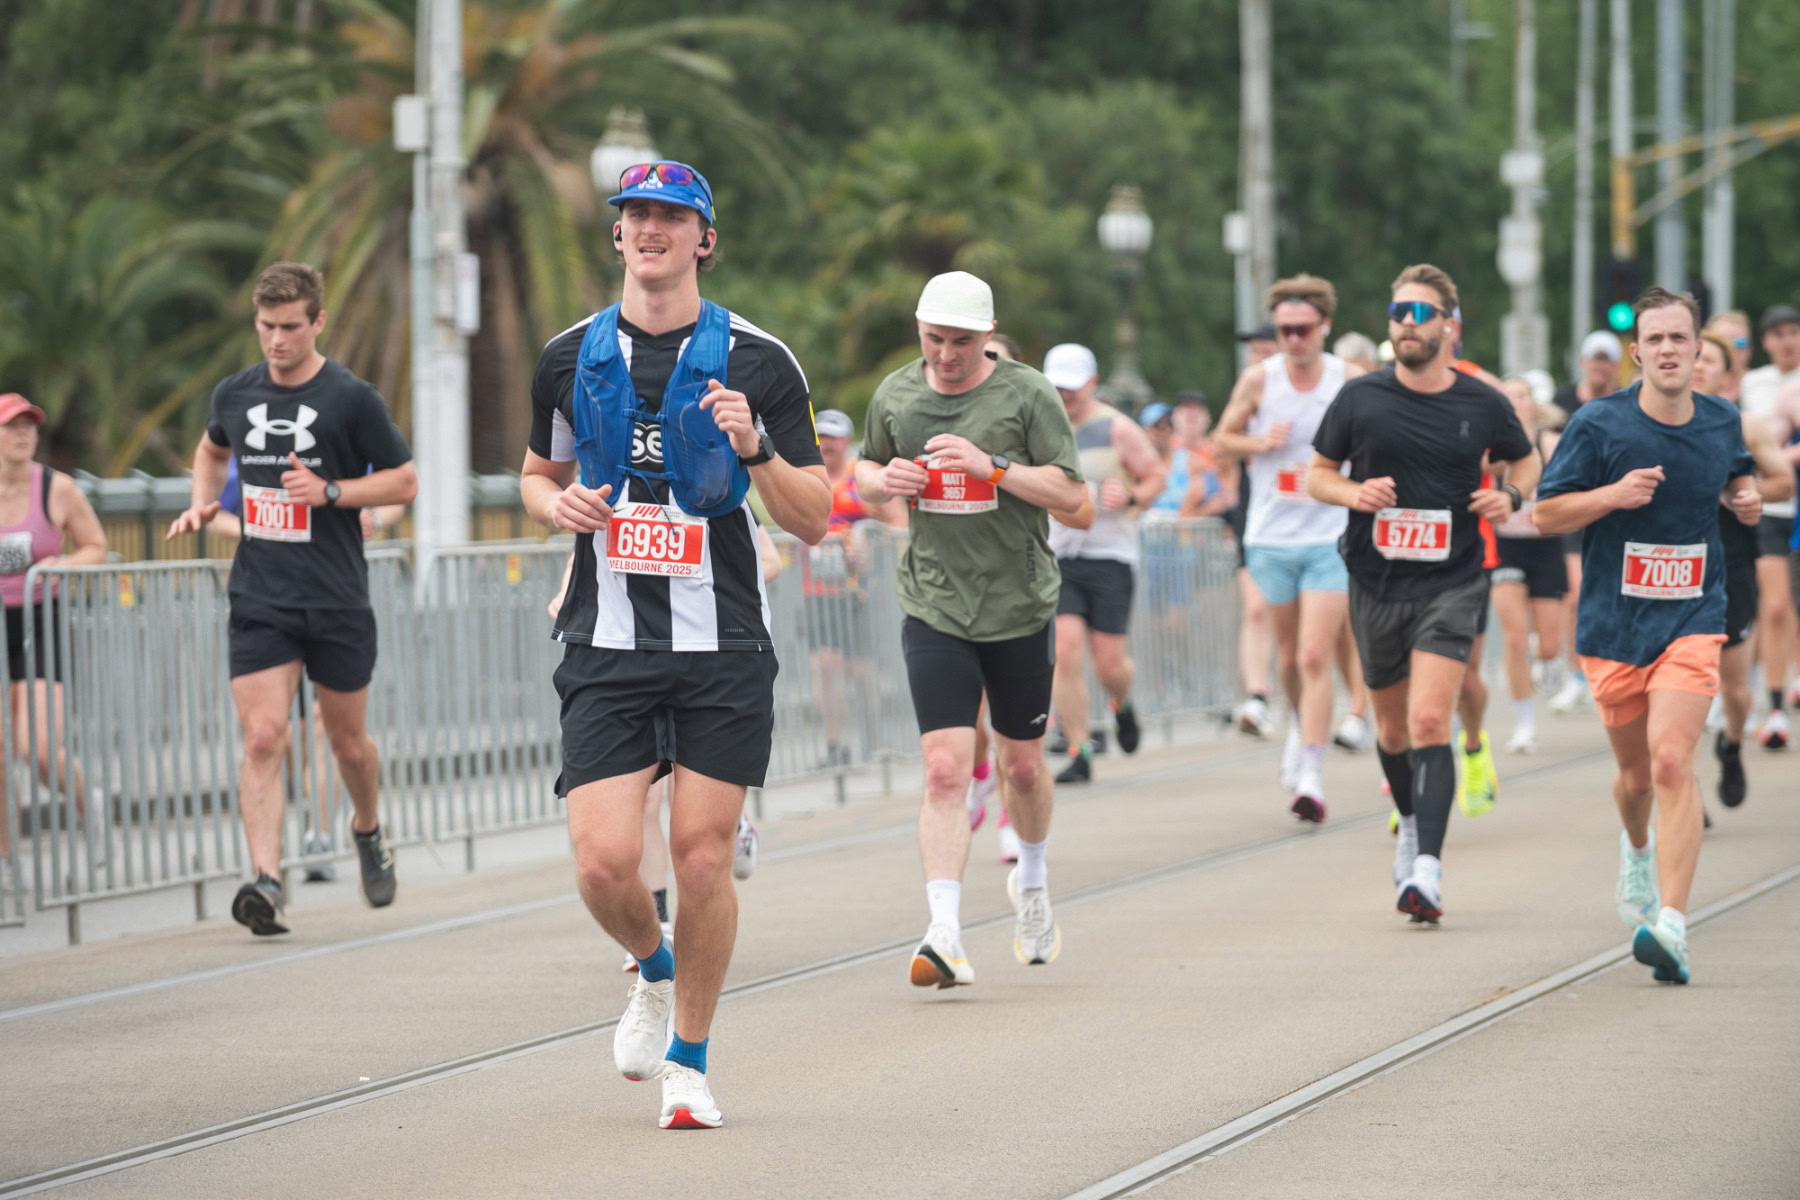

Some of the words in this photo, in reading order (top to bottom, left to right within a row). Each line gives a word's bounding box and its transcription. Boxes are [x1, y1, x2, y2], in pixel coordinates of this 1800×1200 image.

[241, 455, 277, 465] UNDER
[941, 472, 966, 486] MATT
[253, 500, 294, 529] 7001
[617, 521, 686, 561] 6939
[1388, 521, 1437, 547] 5774
[609, 560, 663, 573] MELBOURNE
[666, 564, 692, 575] 2025
[1640, 558, 1693, 587] 7008
